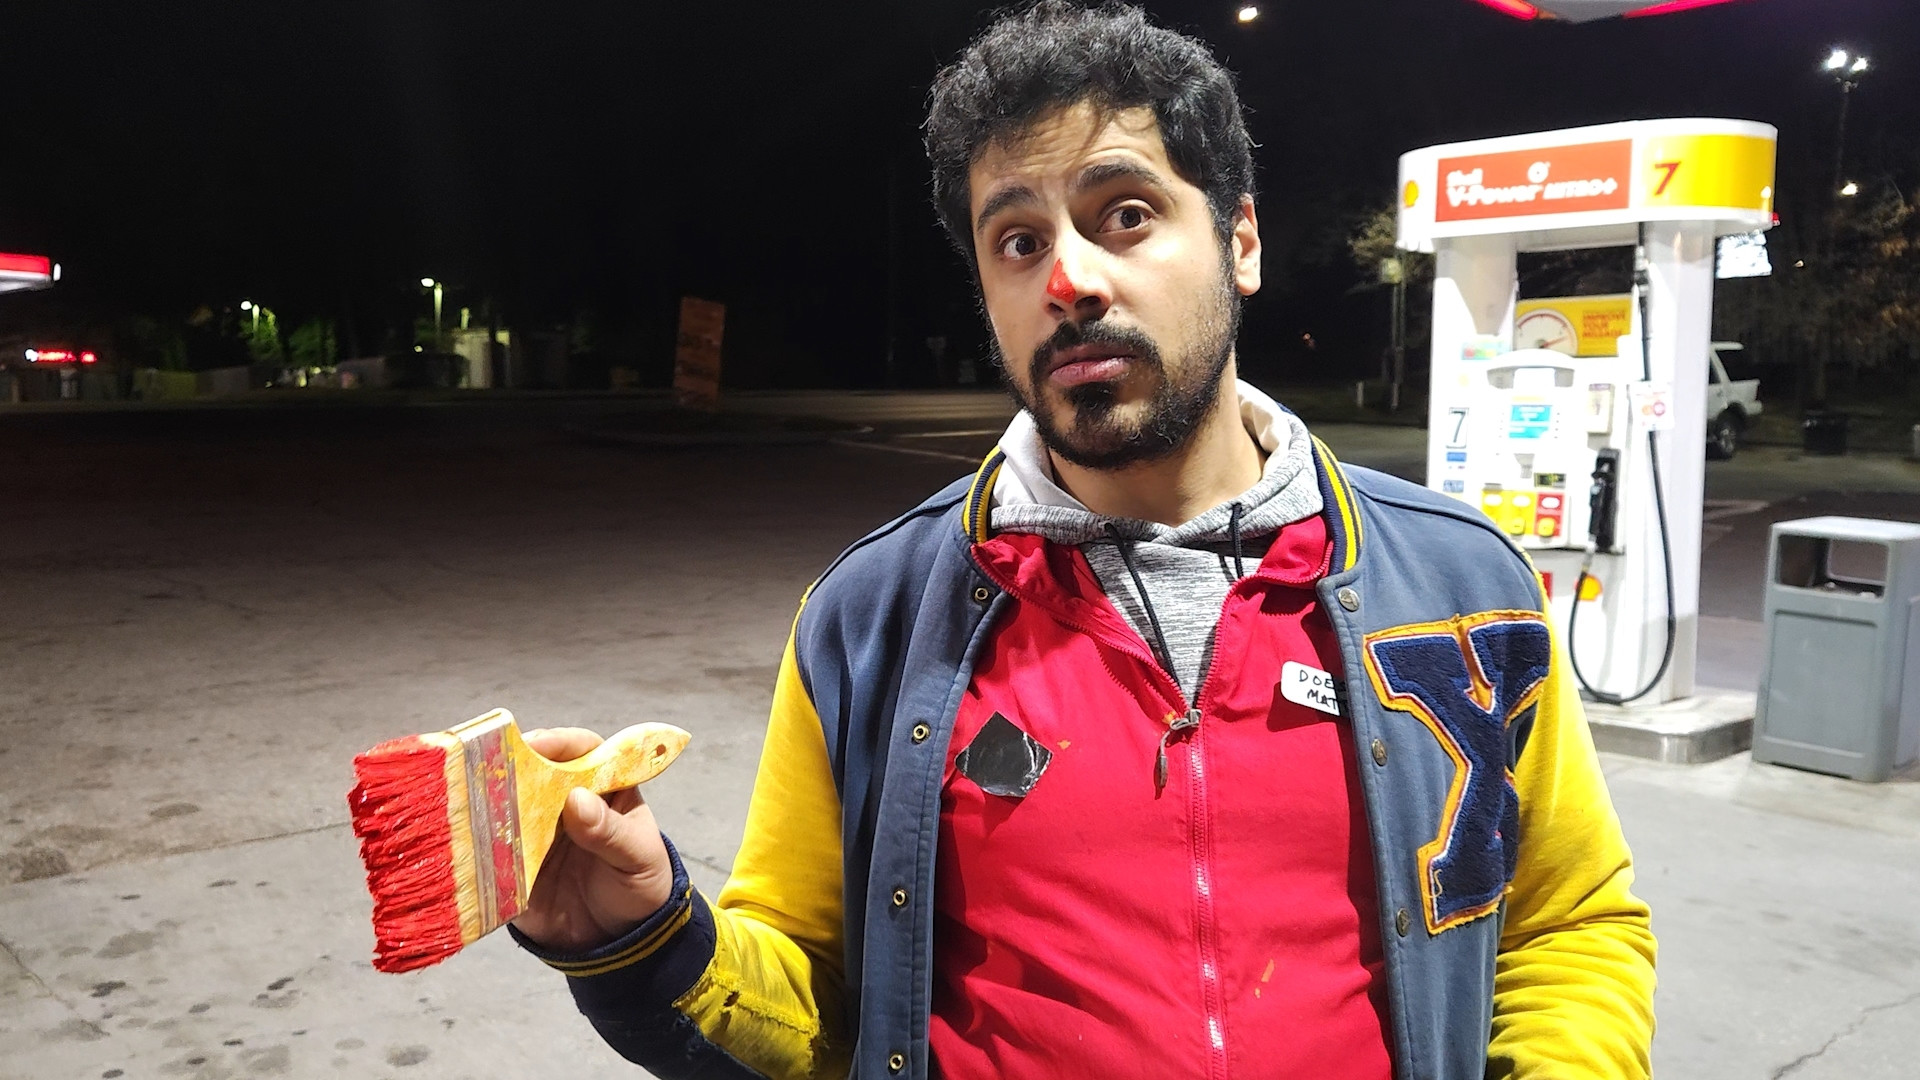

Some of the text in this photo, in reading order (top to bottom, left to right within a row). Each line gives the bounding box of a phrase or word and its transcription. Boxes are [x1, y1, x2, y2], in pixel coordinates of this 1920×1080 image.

[1447, 184, 1544, 207] V-Power
[1654, 161, 1682, 196] 7
[1450, 409, 1467, 443] 7
[1363, 610, 1551, 935] Y
